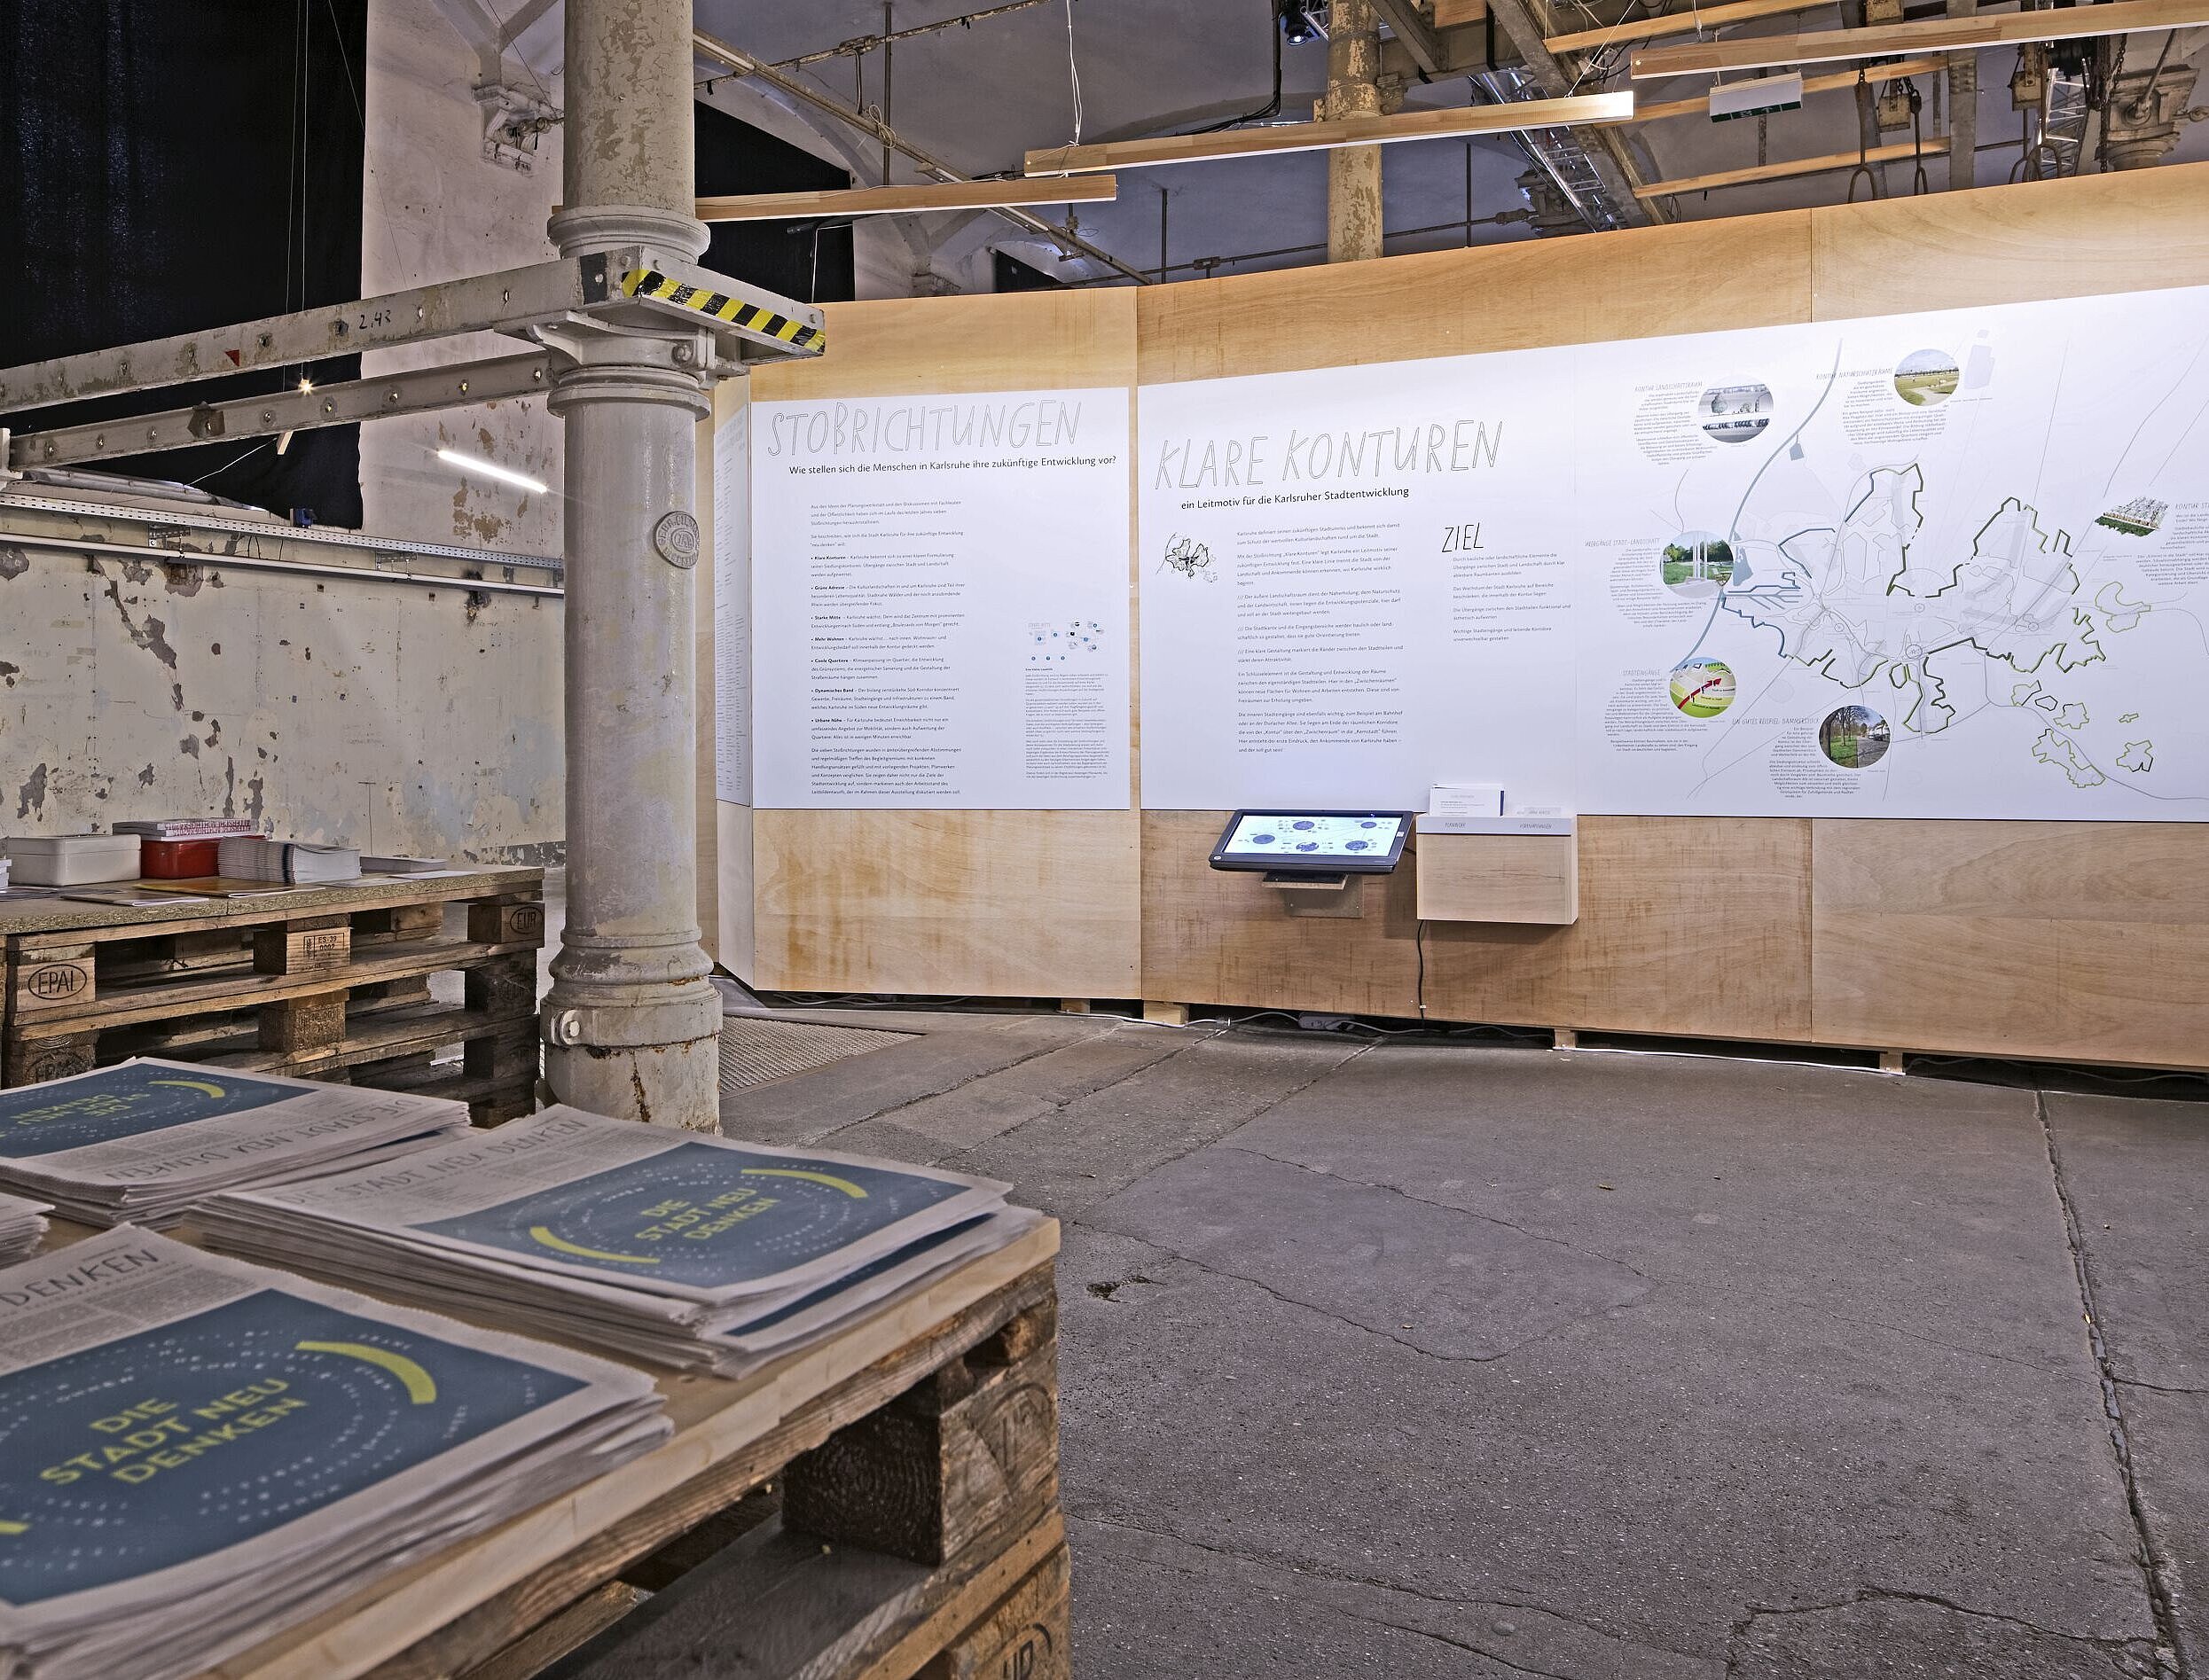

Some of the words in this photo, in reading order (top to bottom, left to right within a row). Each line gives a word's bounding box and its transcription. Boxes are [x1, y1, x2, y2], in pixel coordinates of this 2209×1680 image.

[789, 465, 807, 474] Wie
[808, 464, 835, 473] stellen
[837, 464, 855, 473] sich
[857, 463, 871, 473] die
[873, 462, 916, 472] Menschen
[919, 461, 927, 470] in
[929, 460, 971, 470] Karlsruhe
[973, 460, 991, 469] ihre
[992, 458, 1039, 470] zukünftige
[1042, 457, 1096, 469] Entwicklung
[1098, 455, 1116, 464] vor?
[1155, 436, 1269, 489] KLARE
[1282, 420, 1503, 481] KONTUREN
[1182, 501, 1195, 509] ein
[1198, 496, 1240, 508] Leitmotiv
[1243, 496, 1256, 506] für
[1258, 495, 1272, 505] die
[1275, 492, 1322, 503] Karlsruher
[1325, 488, 1409, 500] Stadtentwicklung
[1441, 522, 1484, 553] ZIEL
[517, 911, 537, 930] EUR
[38, 970, 76, 994] EPAL
[335, 1169, 427, 1197] STADT
[488, 1118, 589, 1154] DENKEN
[634, 1207, 712, 1241] STADT
[705, 1188, 758, 1209] NEU
[640, 1199, 691, 1217] DIE
[683, 1197, 781, 1240] DENKEN
[0, 1248, 159, 1306] DENKEN
[40, 1416, 192, 1485] STADT
[192, 1378, 290, 1420] NEU
[89, 1398, 181, 1434] DIE
[110, 1398, 309, 1485] DENKEN
